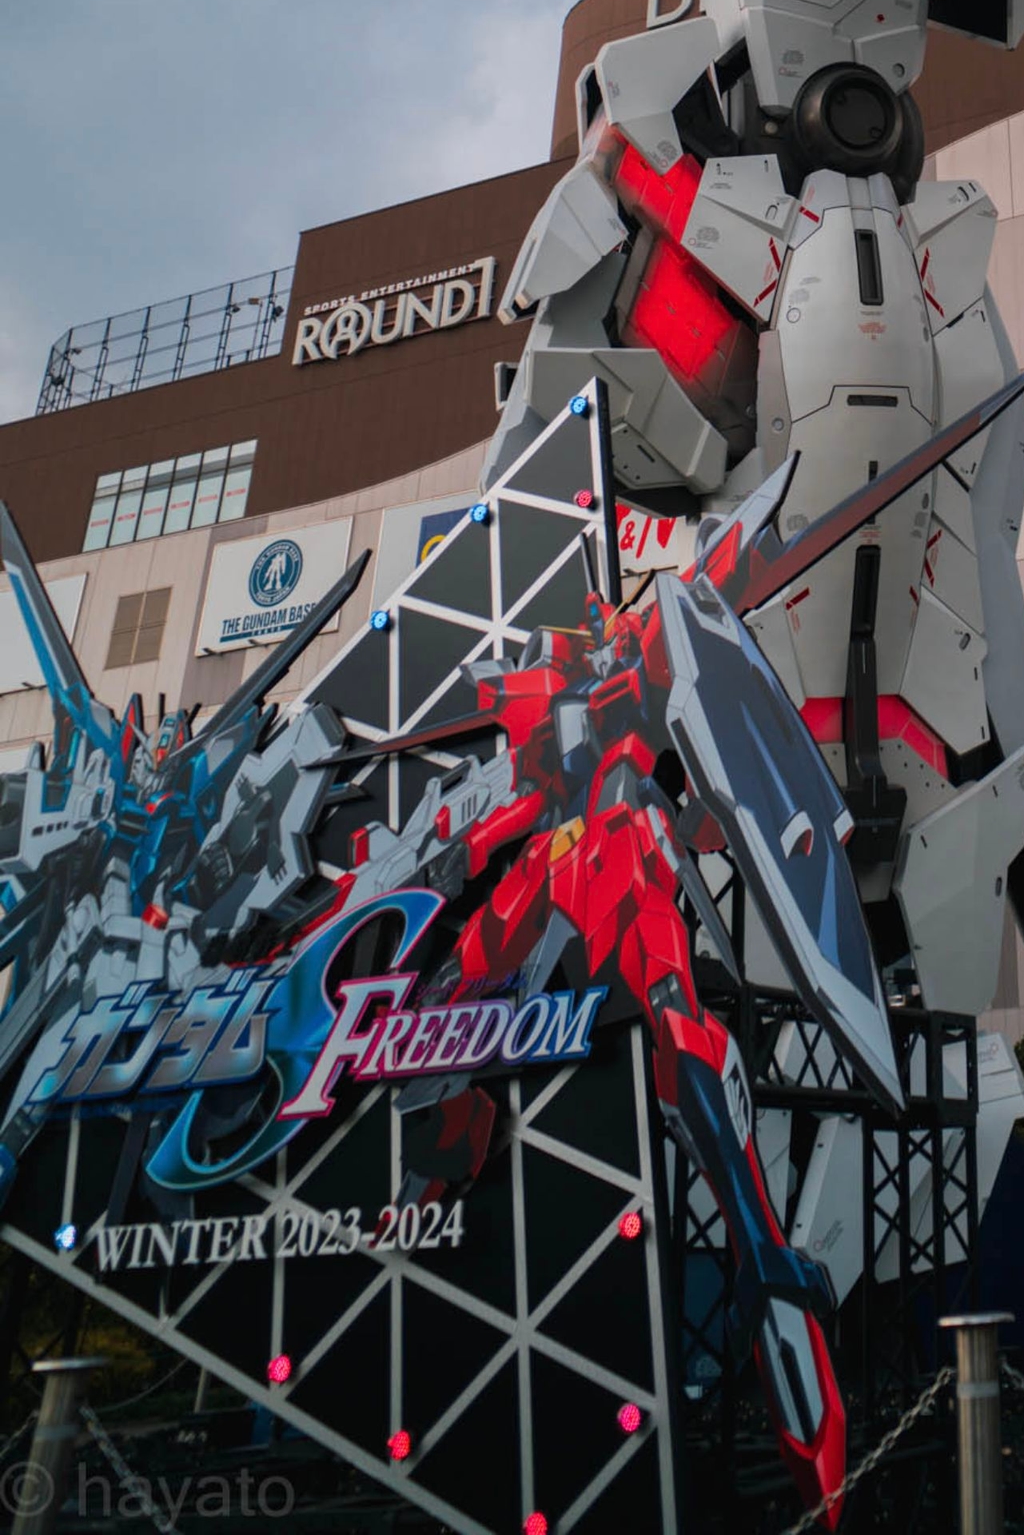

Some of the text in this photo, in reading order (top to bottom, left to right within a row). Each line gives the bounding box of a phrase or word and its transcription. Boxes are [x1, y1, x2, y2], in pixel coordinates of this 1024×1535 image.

[292, 255, 498, 366] ROUND1
[303, 264, 477, 316] SPORTS ENTERTAINMENT
[221, 616, 242, 635] THE
[242, 608, 288, 630] GUNDAM
[25, 966, 282, 1105] ガンダム
[278, 973, 607, 1120] FREEDOM
[98, 1199, 465, 1272] WINTER 2023-2024
